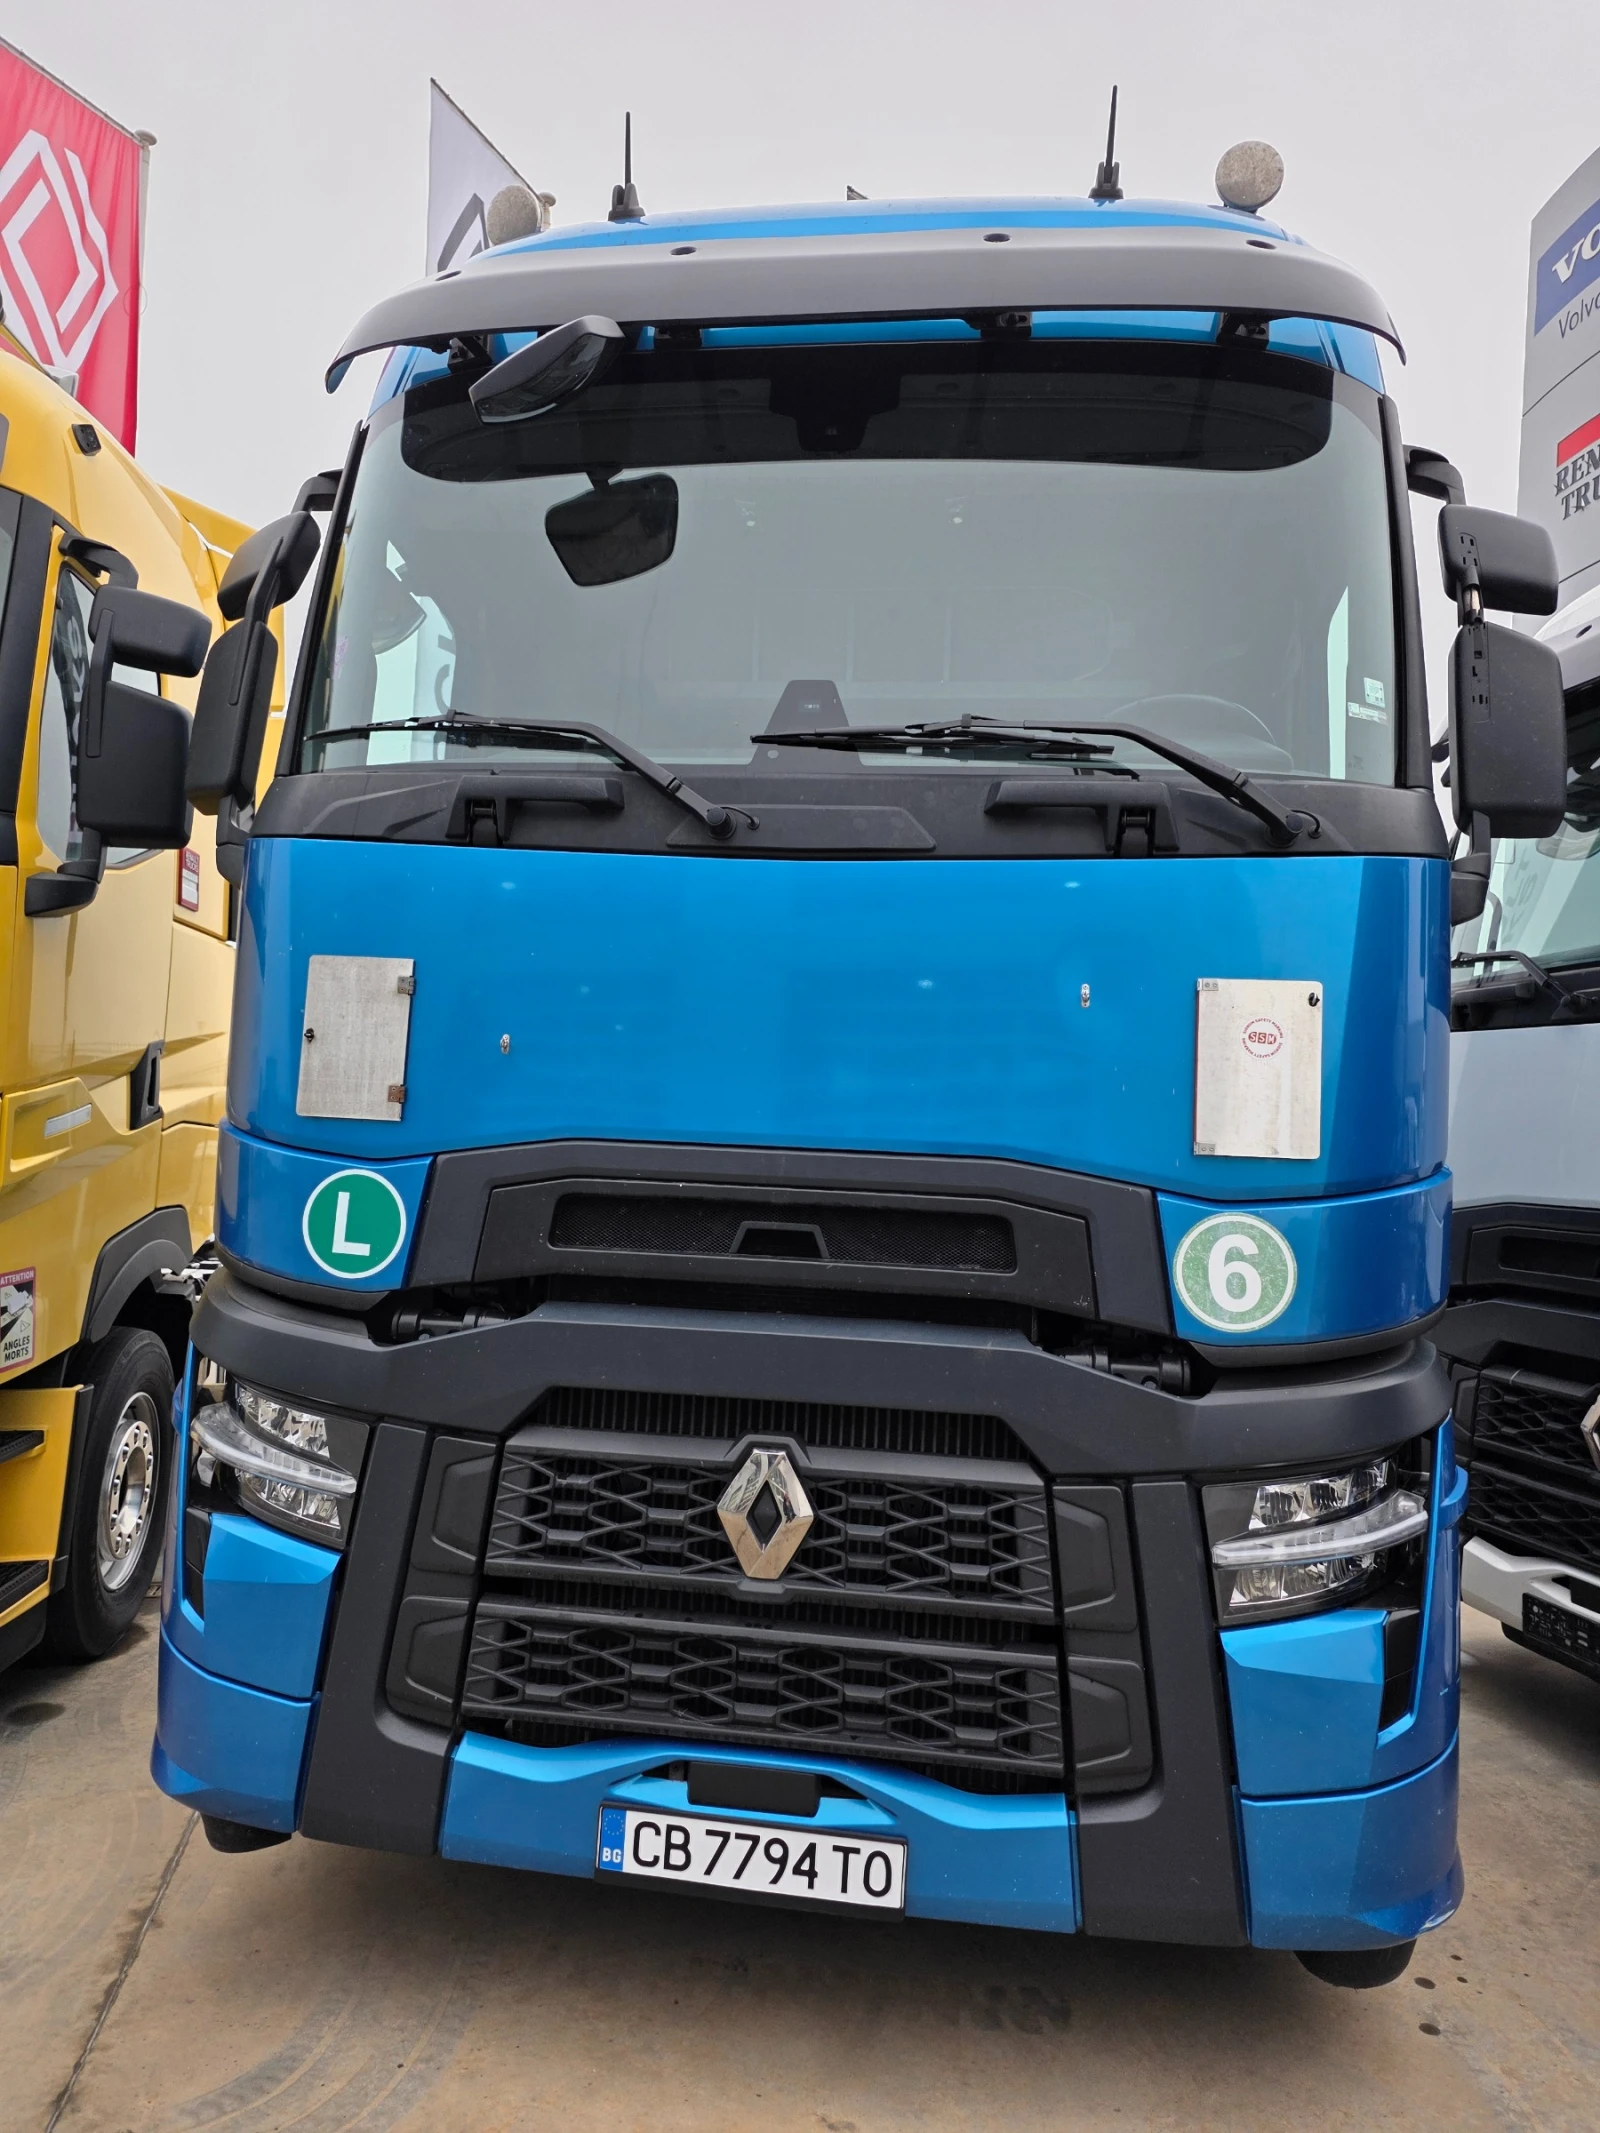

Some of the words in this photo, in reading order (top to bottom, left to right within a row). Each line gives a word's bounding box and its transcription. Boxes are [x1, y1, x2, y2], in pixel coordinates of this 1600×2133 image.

[331, 1191, 371, 1257] L
[0, 1269, 34, 1285] ATTENTION
[1208, 1233, 1262, 1313] 6
[3, 1335, 31, 1353] ANGLES
[4, 1346, 30, 1362] MORTS
[602, 1847, 622, 1864] BG
